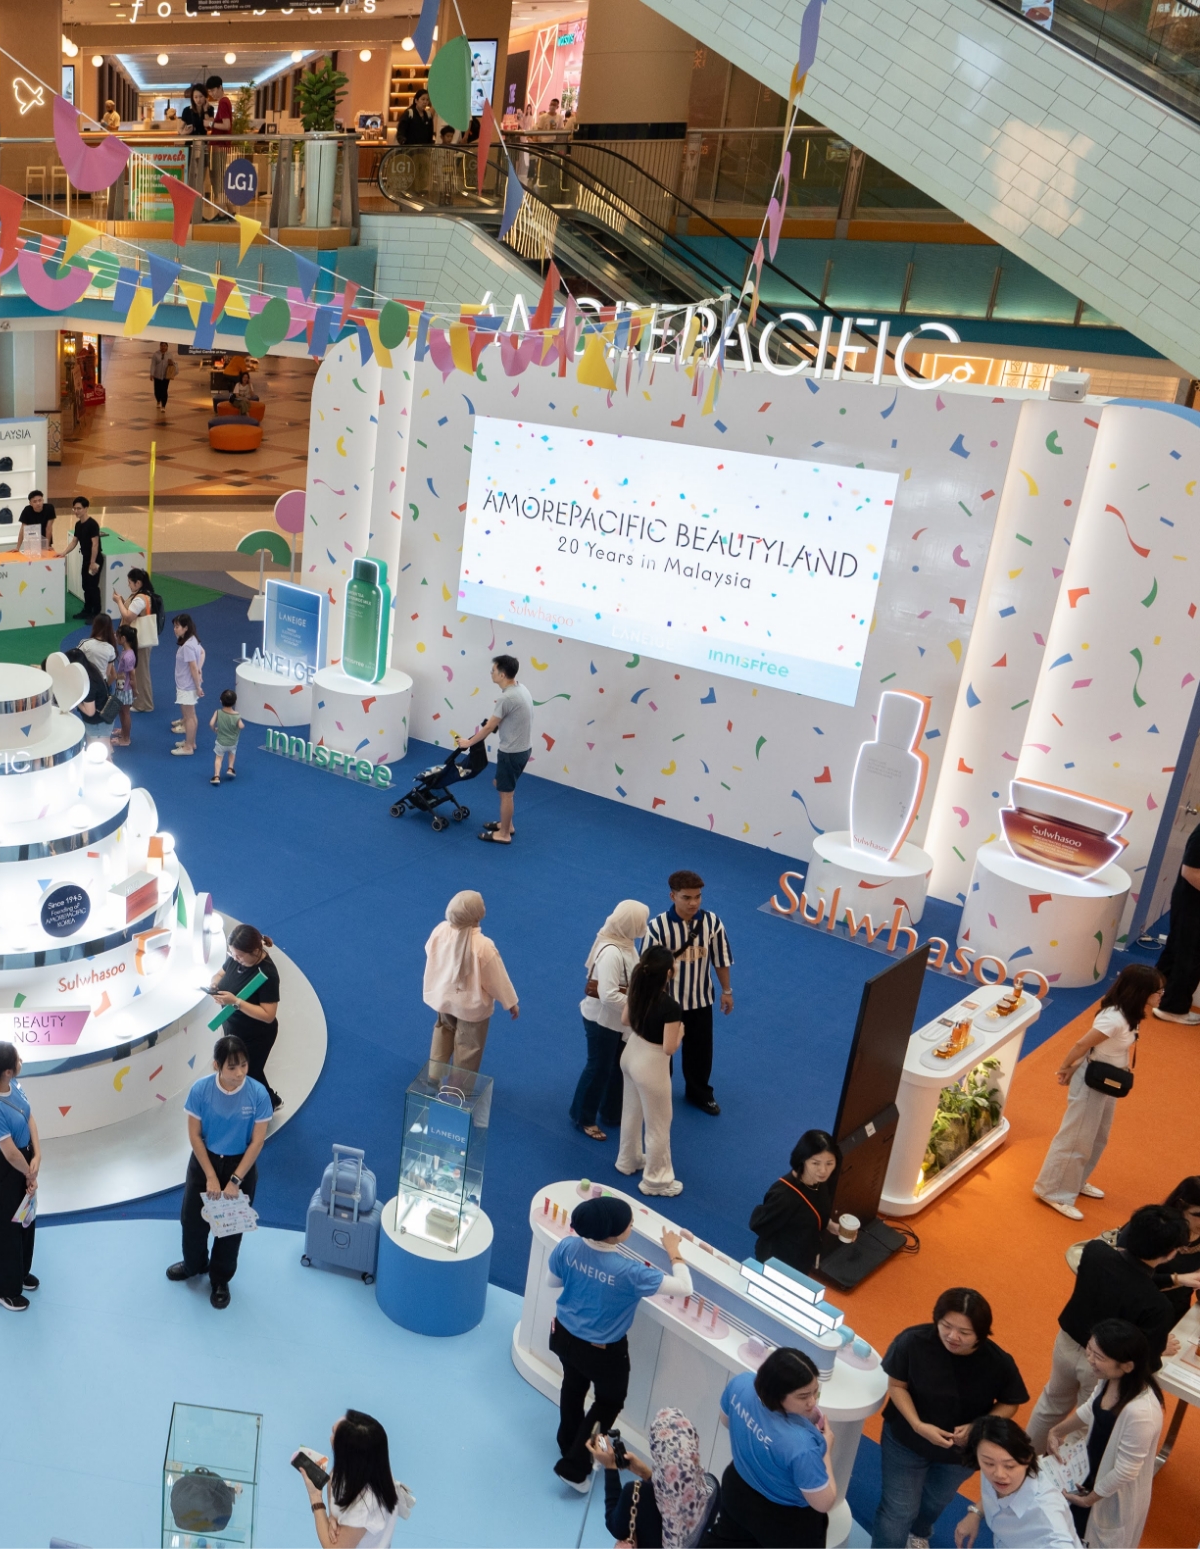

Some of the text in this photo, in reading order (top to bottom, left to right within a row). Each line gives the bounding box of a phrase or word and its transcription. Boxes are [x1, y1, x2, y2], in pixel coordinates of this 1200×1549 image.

[227, 172, 254, 191] LG1
[482, 489, 858, 578] AMOREPACIFIC BEAUTYLAND
[557, 536, 752, 590] 20 Years in Malaysia
[278, 612, 307, 628] LANEIGE
[508, 599, 575, 628] Sulwhasoo
[241, 642, 316, 685] LANEIGE
[1032, 825, 1082, 847] Sulwhasoo
[47, 894, 83, 910] Since 1945
[50, 902, 81, 916] Founding of
[45, 907, 87, 925] AMOREPACIFIC
[56, 917, 76, 928] KOREA
[770, 871, 1049, 1000] Sulwhasoo
[58, 962, 127, 993] Sulwhasoo
[13, 1015, 66, 1029] BEAUTY
[13, 1030, 51, 1043] NO. 1
[430, 1126, 466, 1144] LANEIGE
[566, 1255, 616, 1286] LANEIGE
[730, 1394, 773, 1450] LANEIGE
